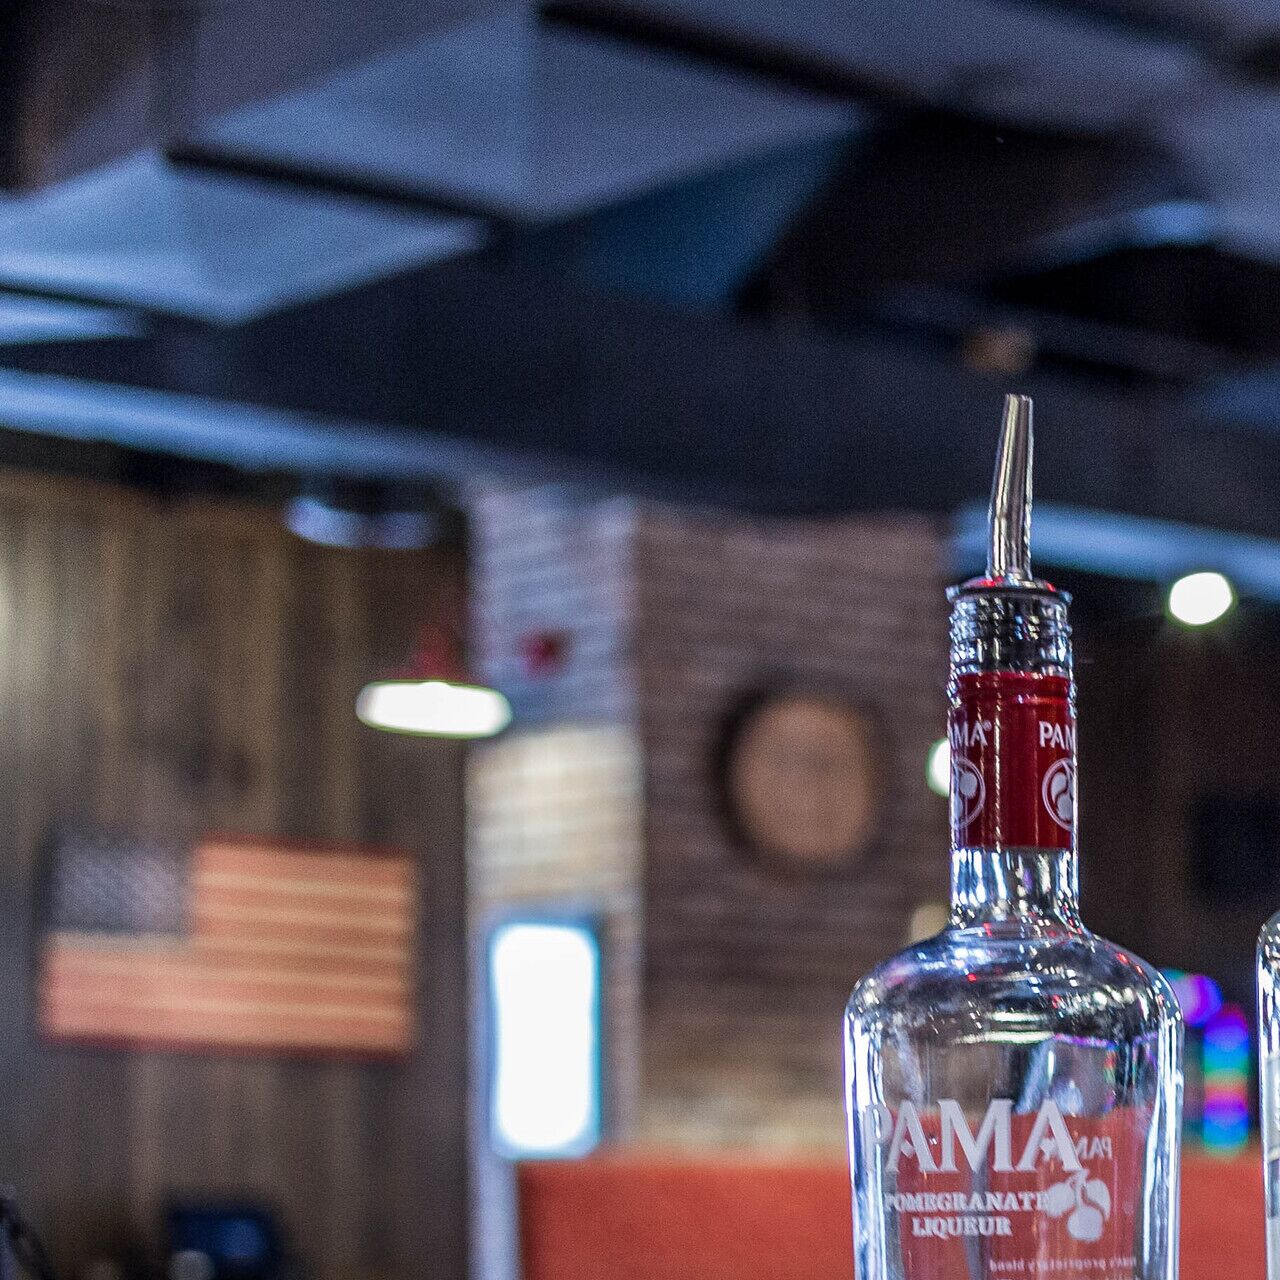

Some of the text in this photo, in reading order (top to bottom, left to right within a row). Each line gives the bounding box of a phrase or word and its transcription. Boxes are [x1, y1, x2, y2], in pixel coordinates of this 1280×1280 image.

[864, 1098, 1084, 1173] PAMA
[884, 1191, 1049, 1213] POMEGRANATE
[911, 1215, 1013, 1238] LIQUEUR
